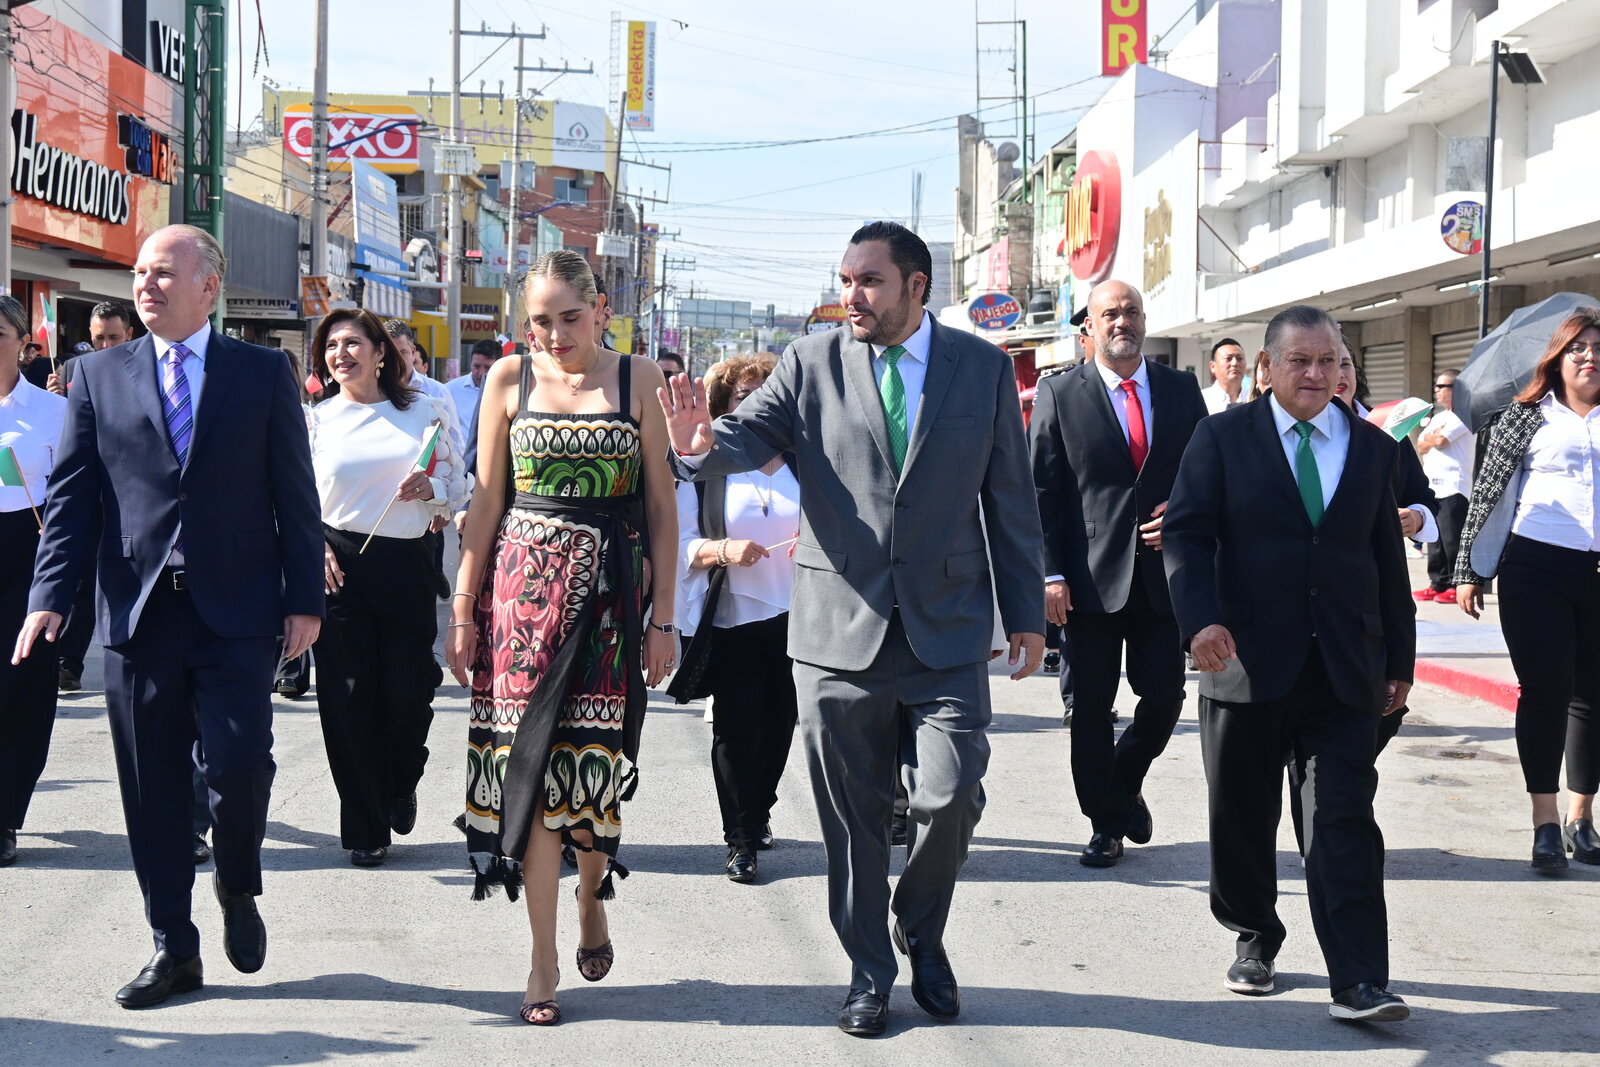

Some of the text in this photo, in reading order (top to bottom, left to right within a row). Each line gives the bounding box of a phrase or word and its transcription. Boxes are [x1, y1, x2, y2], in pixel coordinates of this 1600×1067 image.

[629, 29, 644, 85] elektra
[647, 62, 655, 86] Banco
[287, 118, 412, 157] OXXO
[443, 119, 534, 146] lekta
[556, 138, 577, 148] Banco
[15, 108, 131, 225] Hermanos
[1456, 206, 1481, 218] SMS
[461, 303, 500, 314] PATERIA
[817, 307, 847, 318] LUXO
[969, 300, 1020, 323] VIAJEROS
